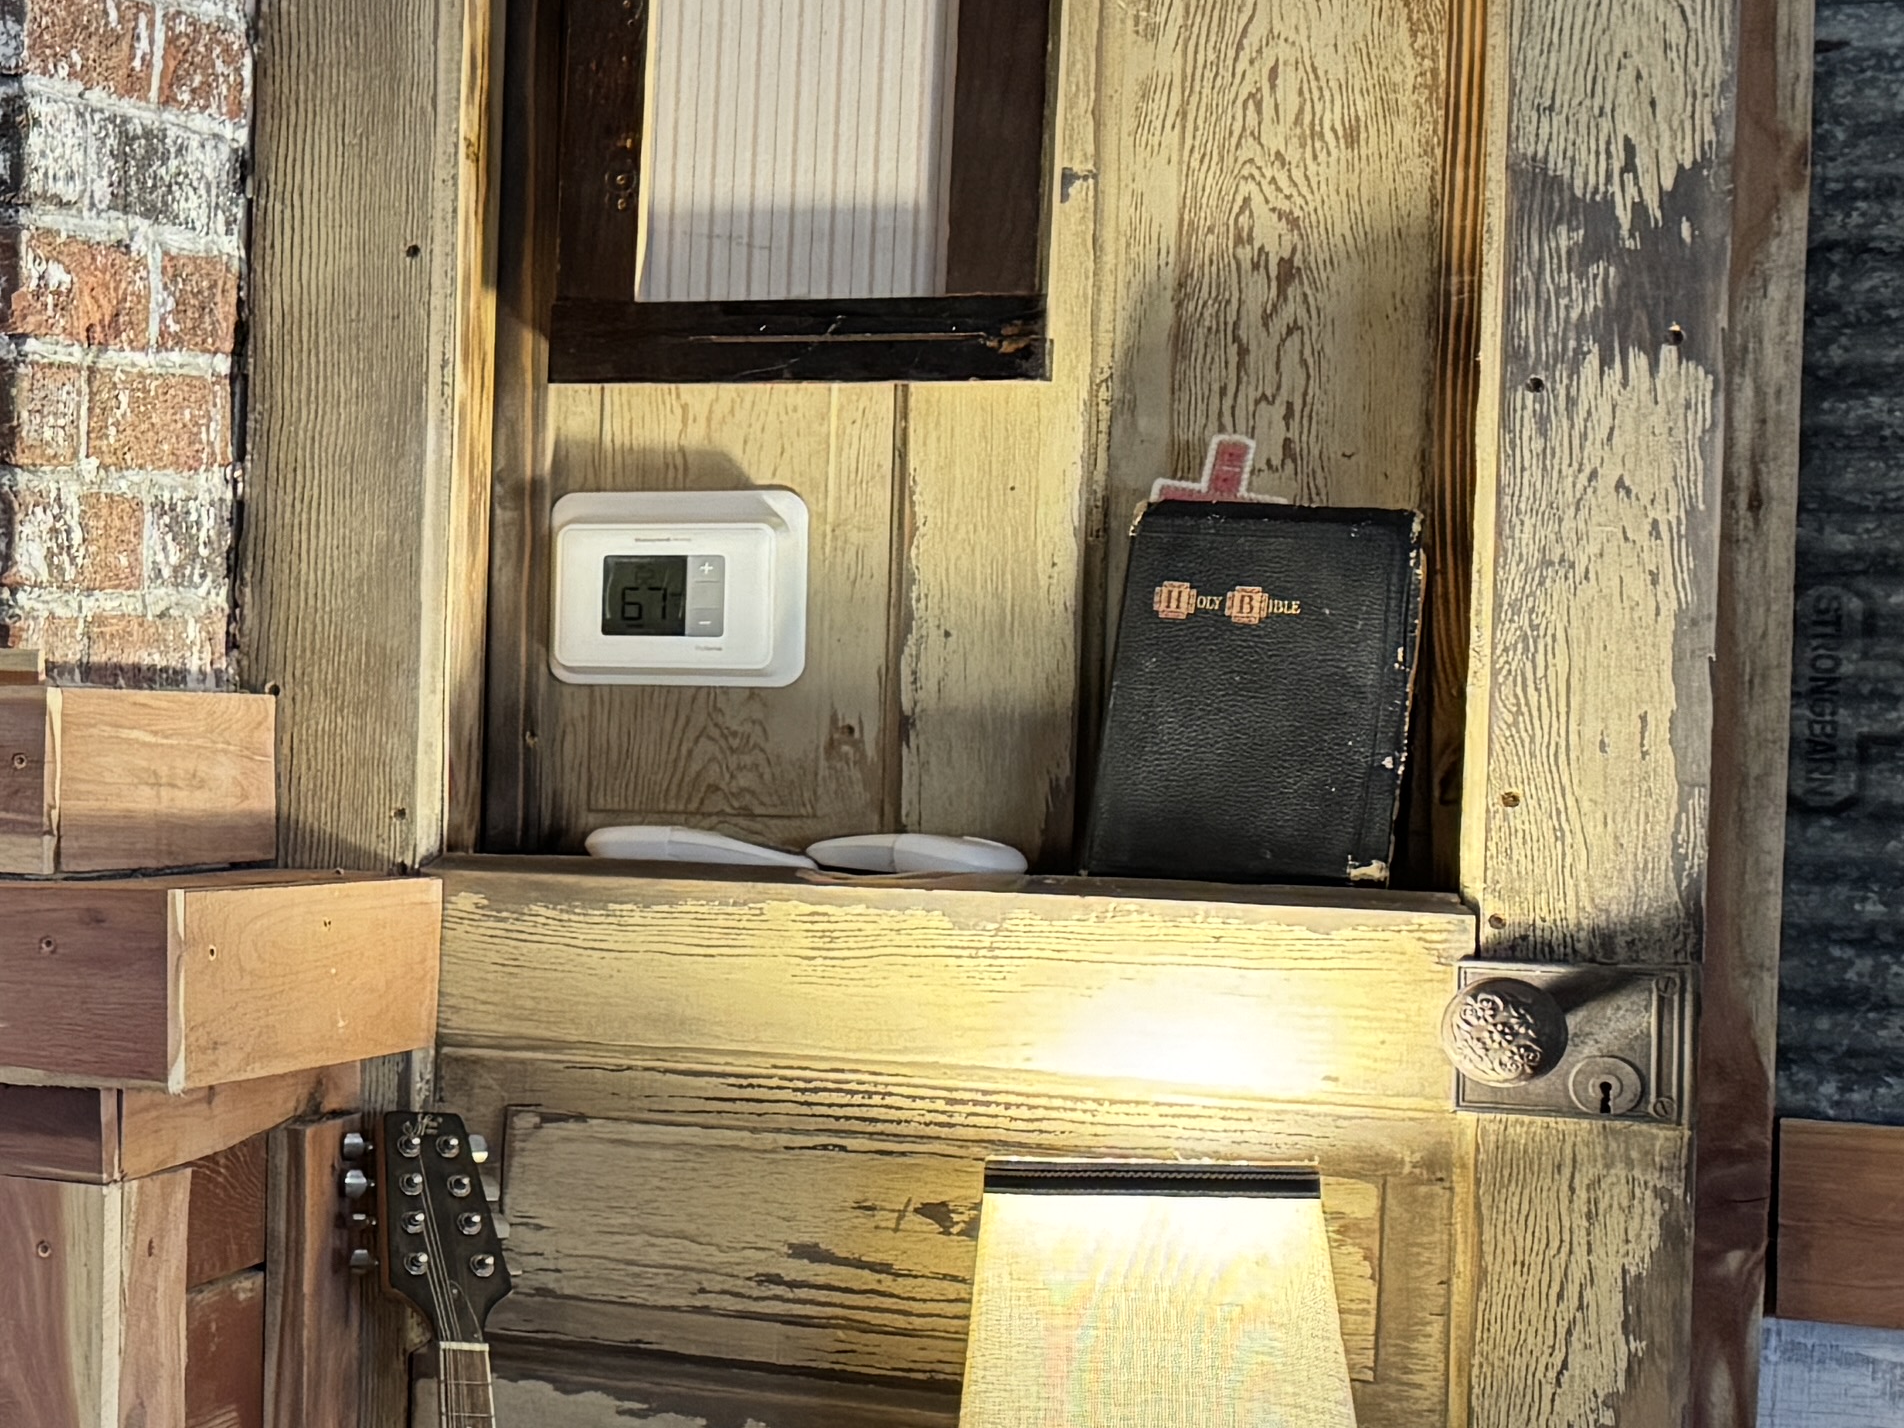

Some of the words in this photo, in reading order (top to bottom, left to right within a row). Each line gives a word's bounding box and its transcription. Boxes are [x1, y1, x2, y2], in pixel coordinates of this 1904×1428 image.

[622, 587, 667, 620] 67
[1158, 585, 1222, 615] HOLY
[1231, 590, 1301, 620] BIBLE
